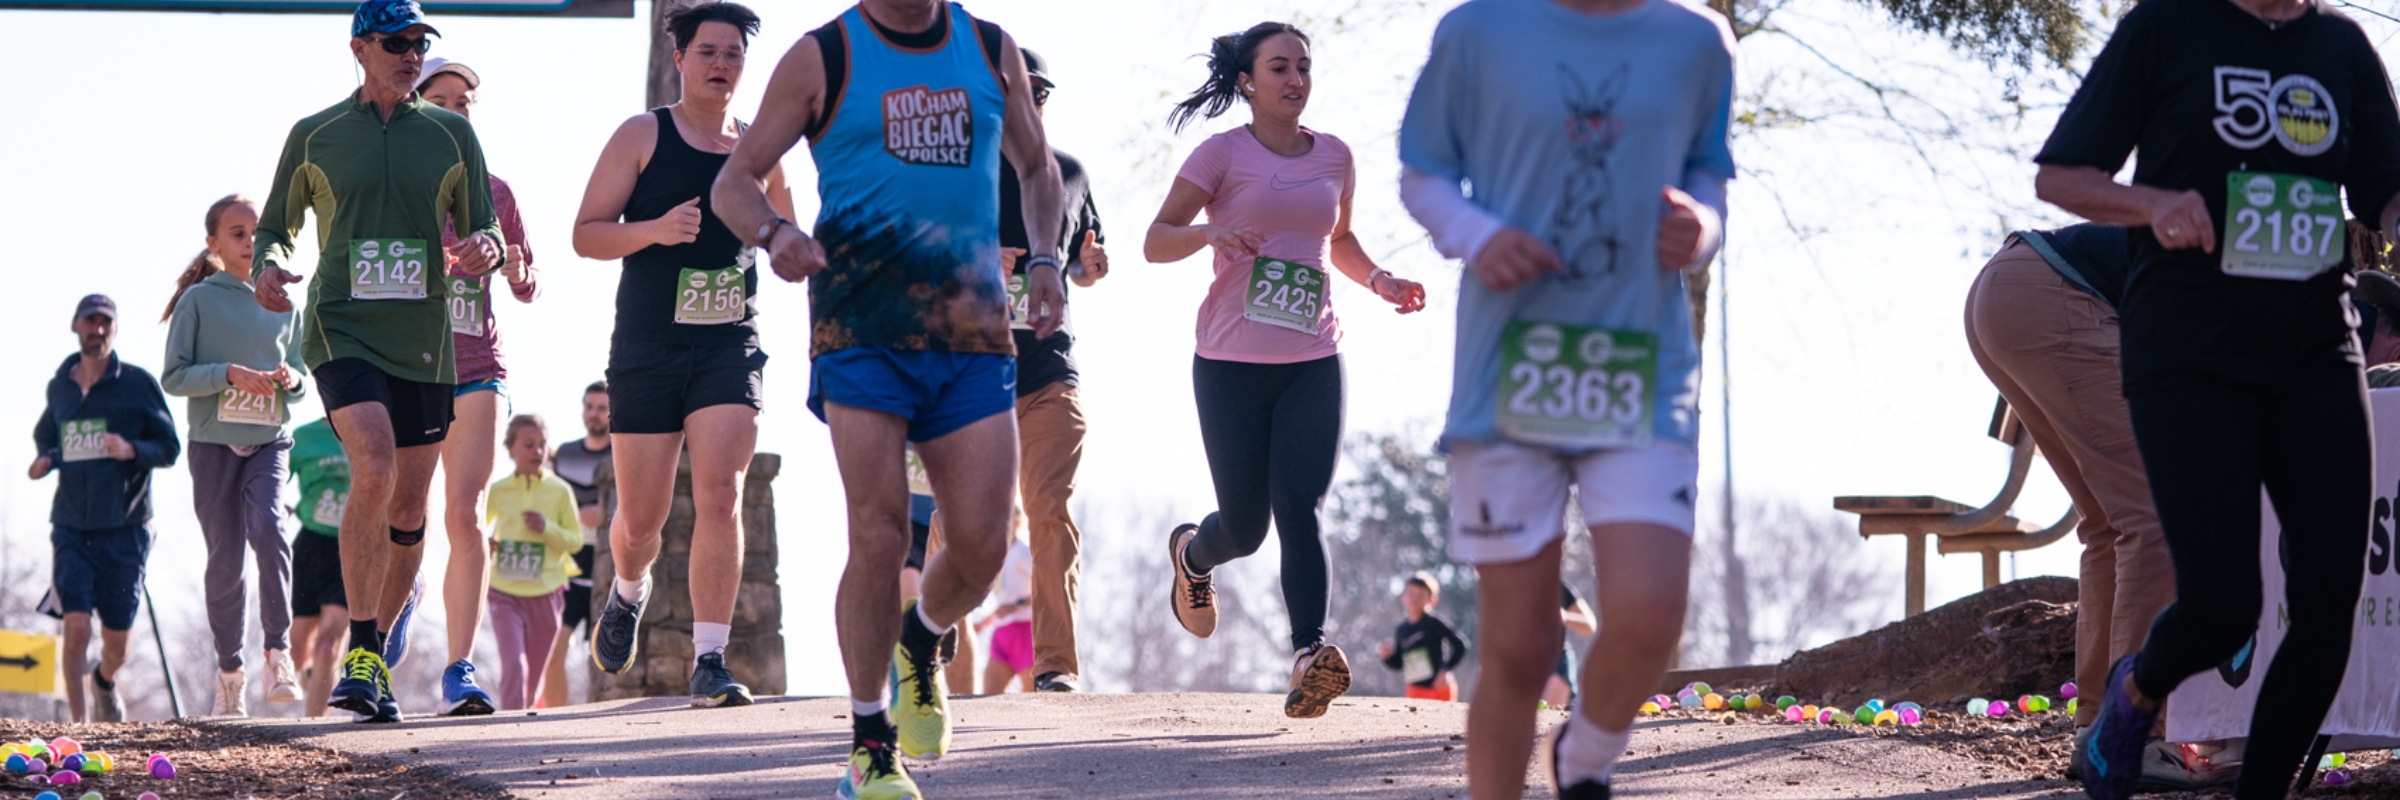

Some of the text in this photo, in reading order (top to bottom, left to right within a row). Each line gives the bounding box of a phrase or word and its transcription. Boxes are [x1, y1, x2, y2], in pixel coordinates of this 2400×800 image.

[887, 89, 967, 120] KOCHAM
[909, 147, 967, 165] POLSCE
[2234, 207, 2338, 258] 2187
[355, 259, 422, 285] 2142
[447, 296, 476, 322] 01
[682, 286, 741, 312] 2156
[1253, 280, 1318, 319] 2425
[223, 388, 276, 413] 2241
[1508, 361, 1644, 426] 2363
[499, 552, 543, 575] 2147
